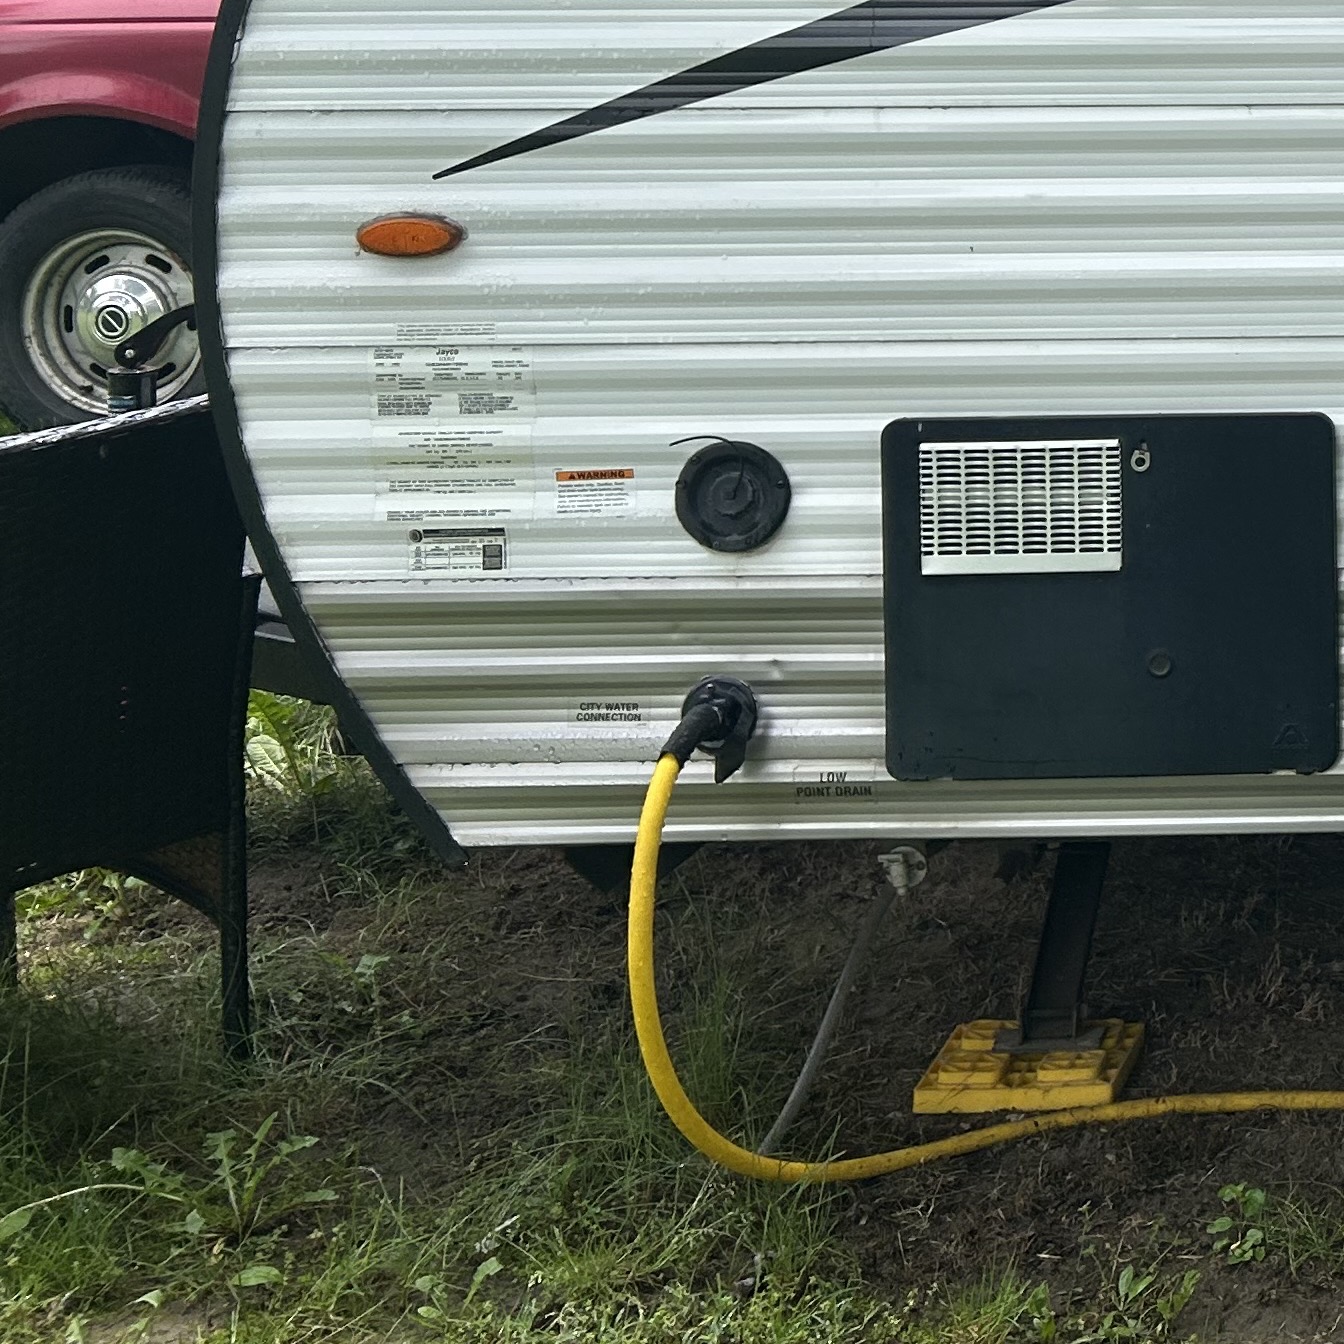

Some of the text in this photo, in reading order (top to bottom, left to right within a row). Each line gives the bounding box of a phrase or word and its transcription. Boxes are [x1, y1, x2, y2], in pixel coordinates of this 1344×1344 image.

[436, 347, 459, 356] Jayco
[576, 470, 625, 480] WARNING
[580, 702, 639, 711] CITY WATER
[576, 712, 641, 722] CONNECTION
[819, 771, 847, 784] LOW
[796, 785, 872, 797] POINT DRAIN
